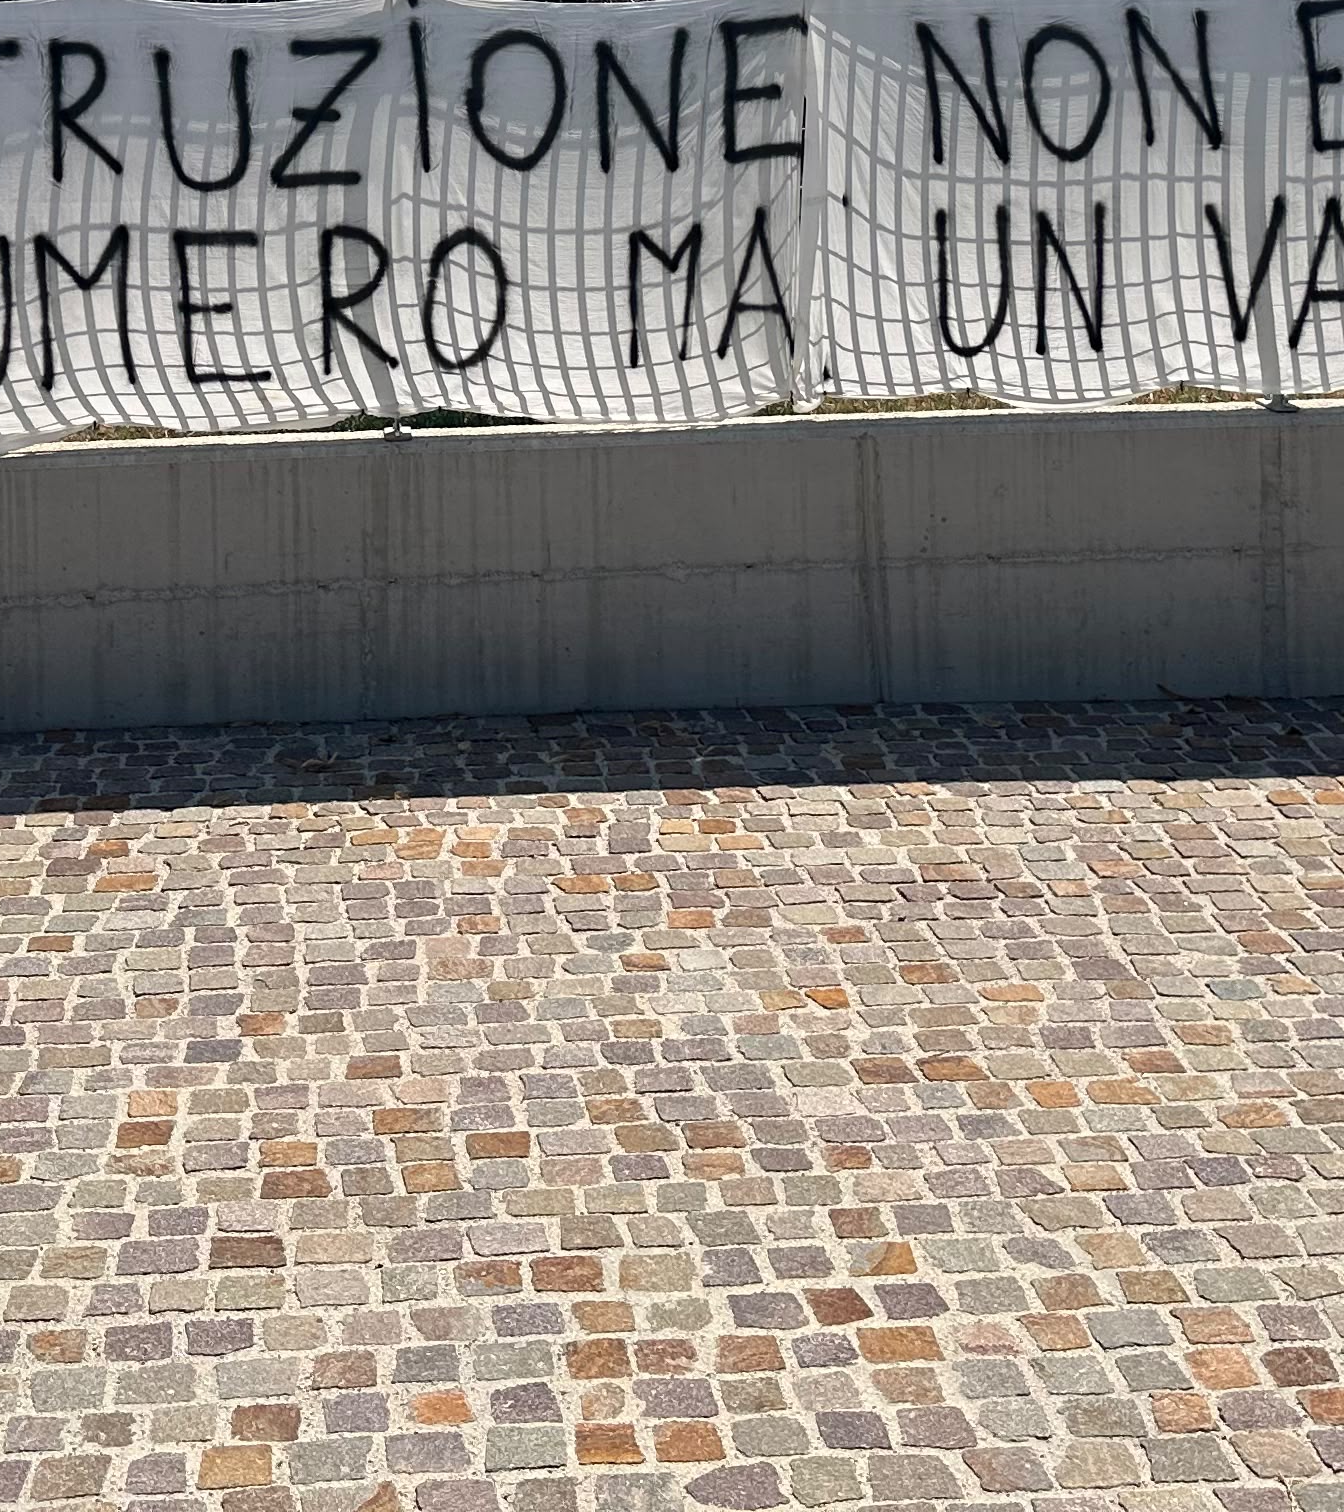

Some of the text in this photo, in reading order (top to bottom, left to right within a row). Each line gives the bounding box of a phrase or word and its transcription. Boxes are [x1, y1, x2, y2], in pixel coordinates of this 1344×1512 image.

[914, 7, 1226, 166] NON
[627, 206, 796, 370] MA
[935, 201, 1108, 359] UN
